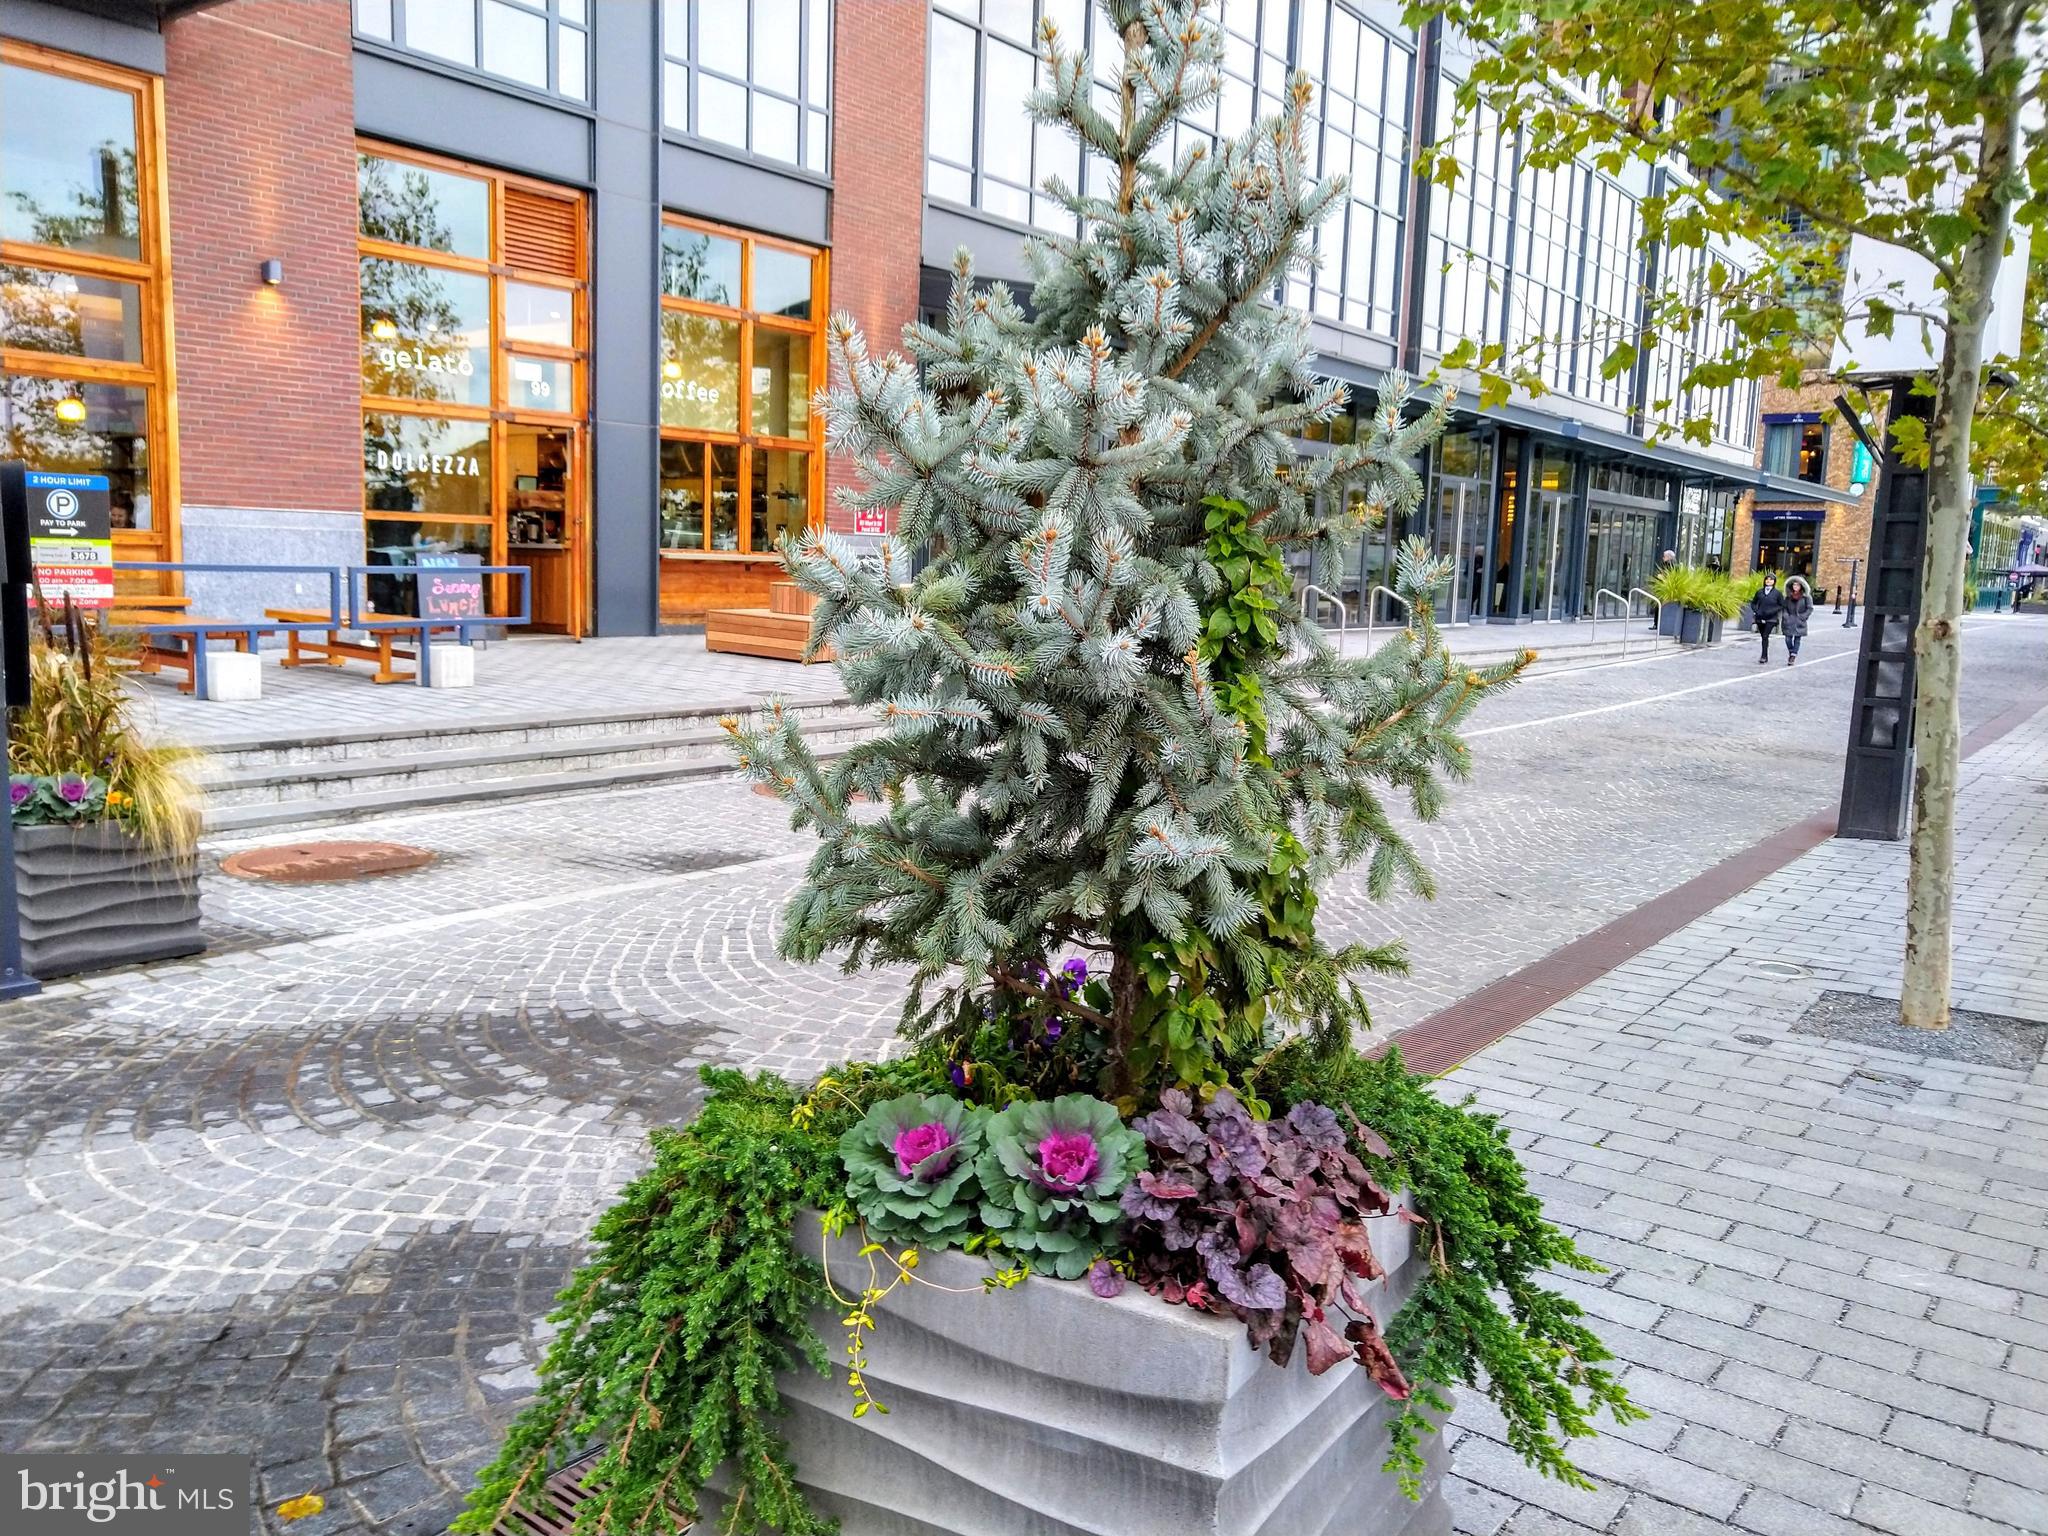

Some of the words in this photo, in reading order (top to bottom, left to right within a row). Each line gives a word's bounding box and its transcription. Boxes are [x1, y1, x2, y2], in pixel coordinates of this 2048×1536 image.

[380, 348, 474, 377] gelato
[531, 381, 551, 397] 99
[661, 380, 720, 403] offee
[377, 450, 480, 476] DOLCEZZA
[32, 475, 39, 484] 2
[40, 476, 66, 485] HOUR
[68, 478, 91, 487] LIMIT
[73, 552, 96, 560] 3678
[38, 568, 52, 576] NO
